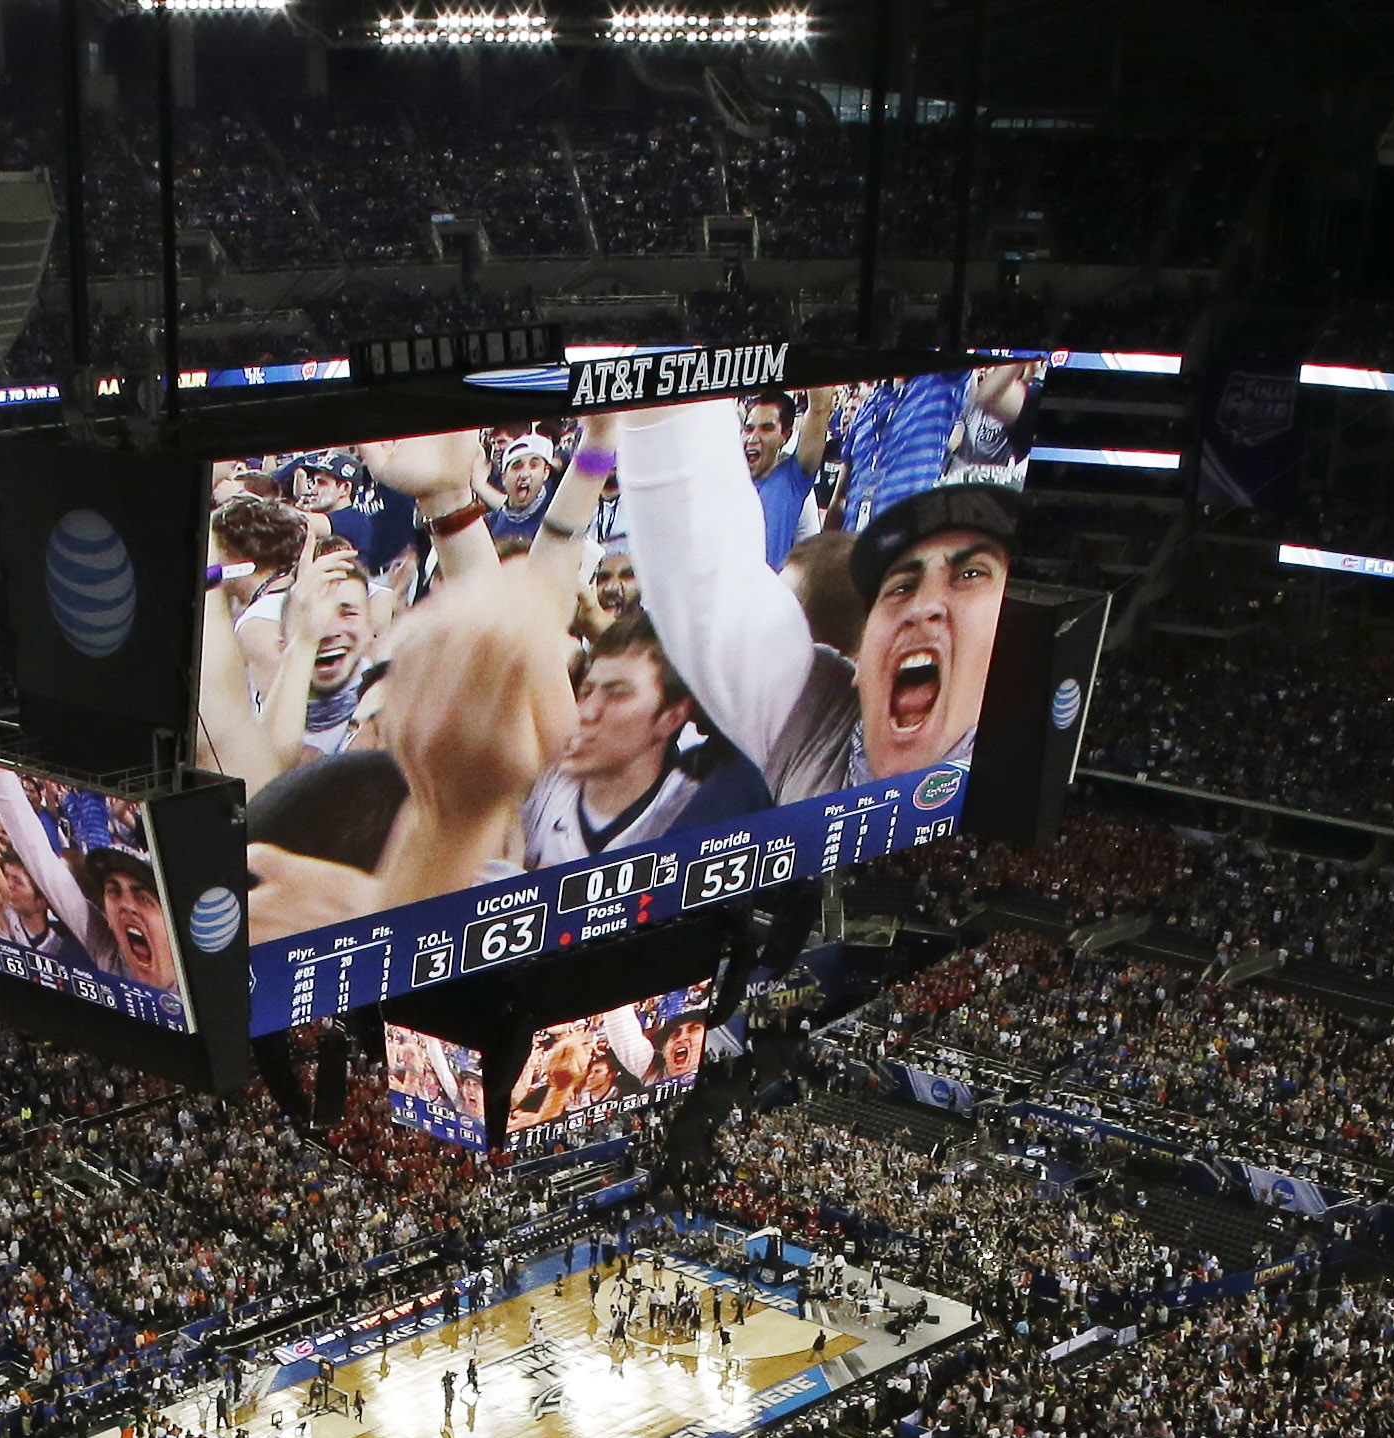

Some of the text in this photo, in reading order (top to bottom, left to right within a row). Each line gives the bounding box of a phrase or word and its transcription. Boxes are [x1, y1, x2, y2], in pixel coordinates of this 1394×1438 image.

[572, 342, 789, 406] AT&T STADIUM
[8, 388, 24, 402] TO
[937, 824, 946, 836] 9
[700, 831, 750, 855] Florida
[660, 853, 676, 865] Half
[773, 856, 790, 879] 0
[586, 862, 634, 902] 0.0
[664, 866, 675, 883] 2
[701, 855, 748, 897] 53
[476, 886, 539, 916] UCONN
[587, 903, 625, 922] Poss.
[417, 930, 453, 947] T.O.L.
[481, 914, 537, 961] 63
[581, 917, 627, 941] Bonus
[288, 926, 393, 962] Plyr. Pts. Fls.
[6, 957, 25, 976] 63
[294, 945, 391, 980] #02 20 3
[428, 953, 448, 979] 3
[292, 970, 389, 1006] #05 11 3
[293, 958, 390, 994] #03 4 0
[78, 981, 98, 1000] 53
[291, 982, 387, 1019] #11 13 0
[1254, 1260, 1296, 1285] UCONN
[750, 1375, 817, 1413] HERE
